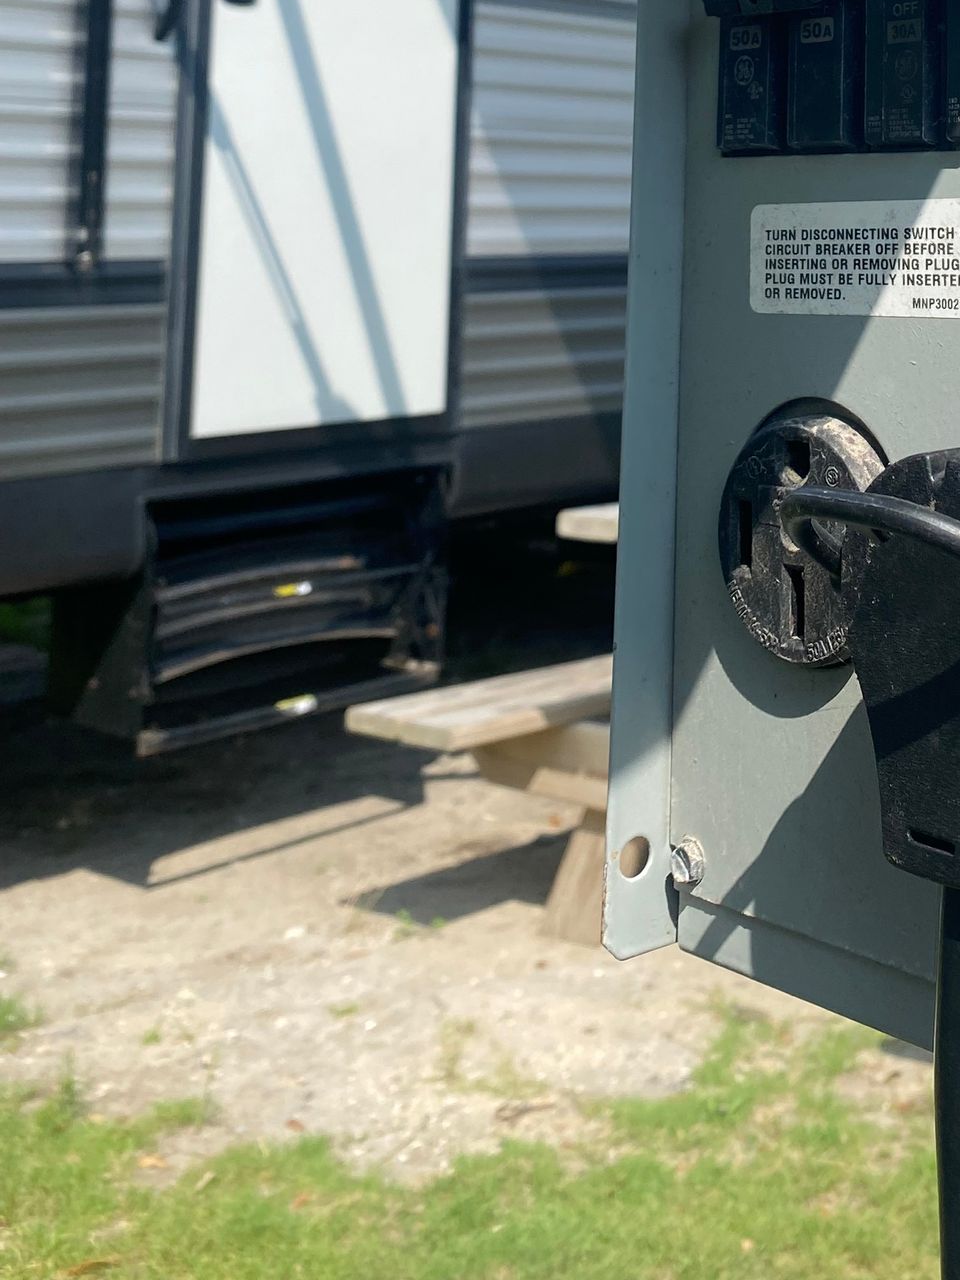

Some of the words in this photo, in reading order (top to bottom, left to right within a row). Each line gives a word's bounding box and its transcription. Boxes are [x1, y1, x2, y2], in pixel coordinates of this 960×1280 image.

[893, 2, 918, 16] OFF
[802, 22, 832, 39] 50A
[890, 22, 916, 39] 30A
[731, 30, 760, 47] 50A
[765, 229, 796, 241] TURN
[801, 227, 898, 241] DISCONNECTING
[904, 227, 954, 240] SWITCH
[765, 243, 810, 255] CIRCUIT
[815, 243, 870, 255] BREAKER
[876, 243, 899, 255] OFF
[904, 243, 954, 255] BEFORE
[765, 258, 827, 270] INSERTING
[832, 258, 848, 270] OR
[853, 258, 919, 270] REMOVING
[765, 273, 795, 285] PLUG
[800, 273, 833, 285] MUST
[838, 273, 853, 285] BE
[858, 273, 897, 286] FULLY
[765, 288, 780, 300] OR
[785, 288, 846, 301] REMOVED.
